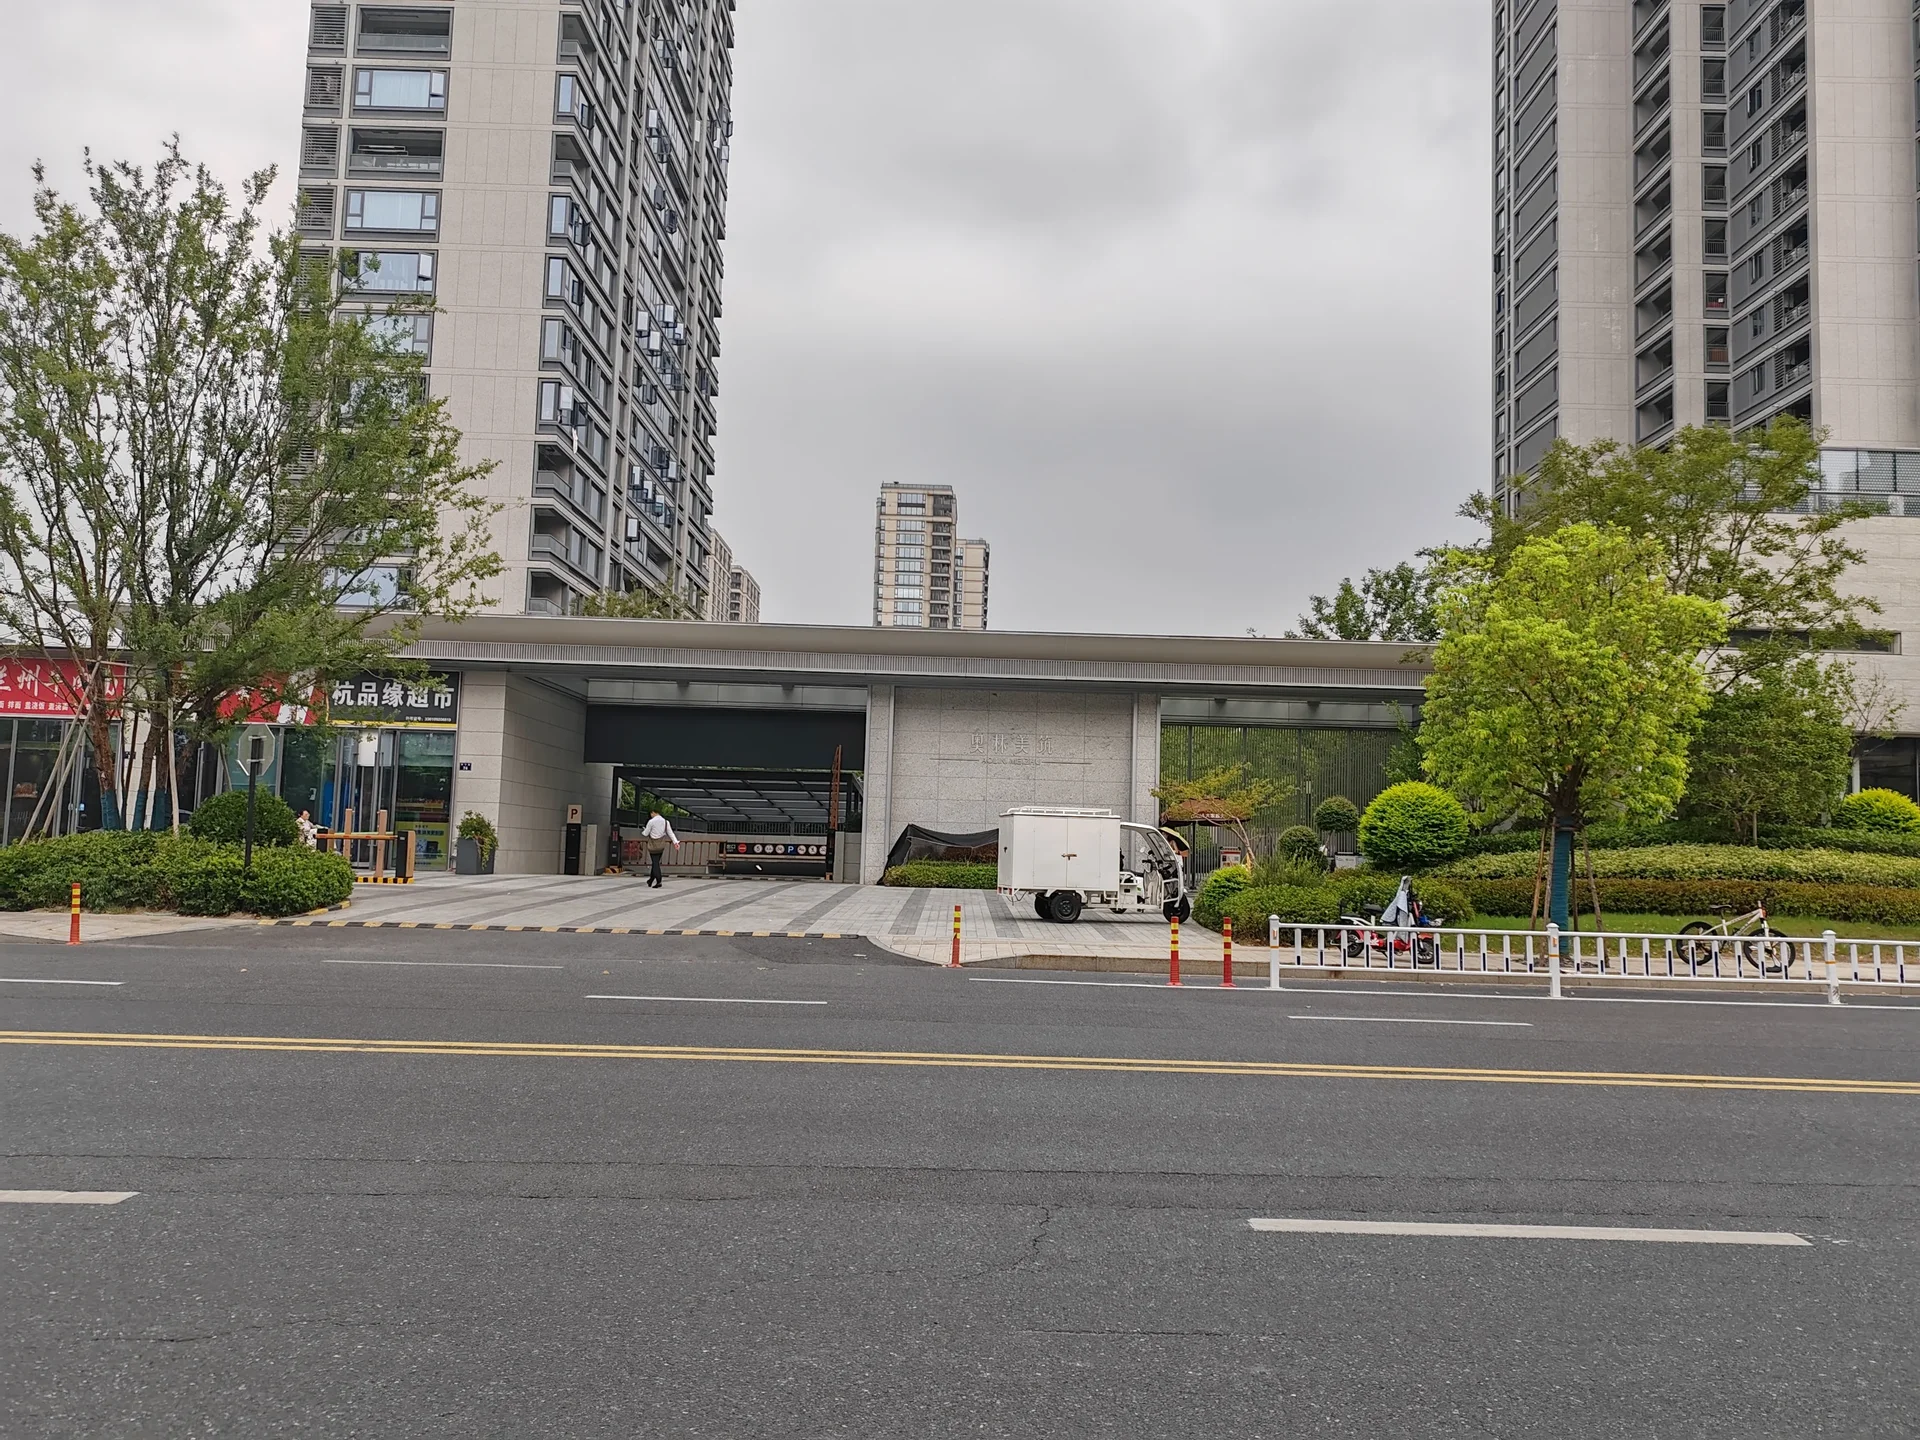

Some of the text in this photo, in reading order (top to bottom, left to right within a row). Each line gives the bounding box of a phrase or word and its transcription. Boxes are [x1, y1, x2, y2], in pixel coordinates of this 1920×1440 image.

[332, 680, 455, 709] 杭品缘超市
[970, 729, 1053, 755] 奥林美筑
[570, 808, 578, 819] P
[787, 845, 795, 854] P
